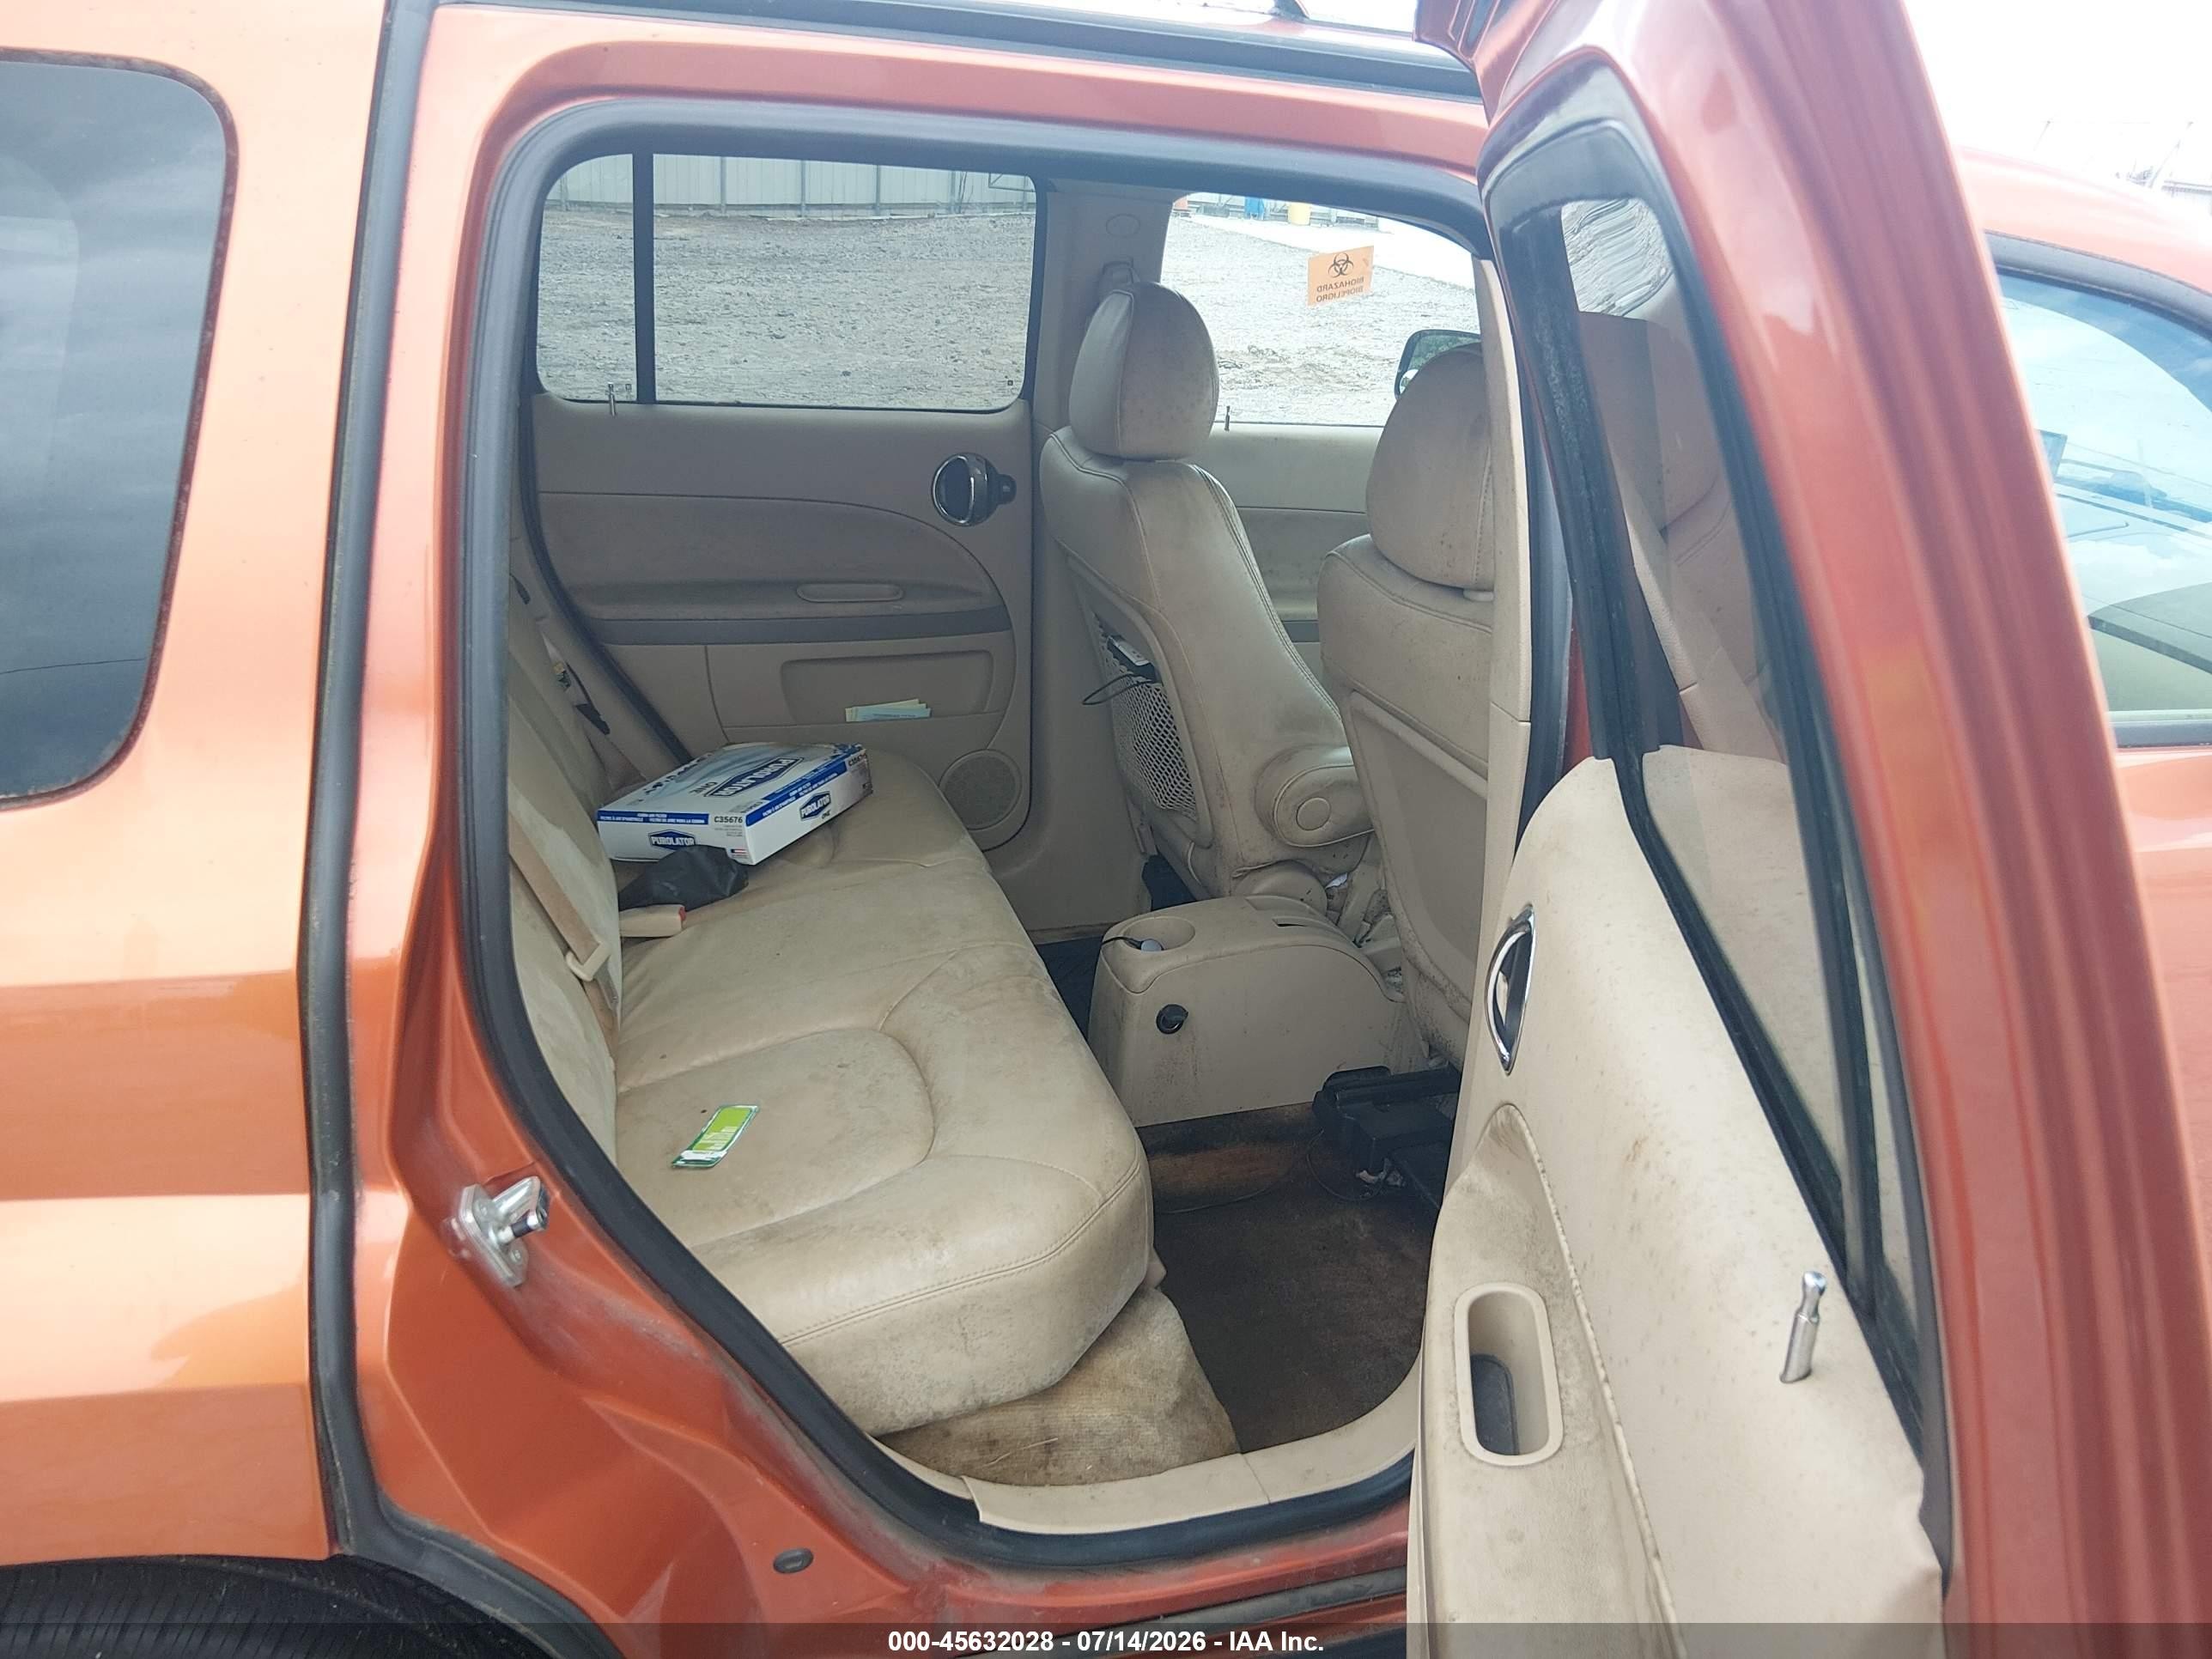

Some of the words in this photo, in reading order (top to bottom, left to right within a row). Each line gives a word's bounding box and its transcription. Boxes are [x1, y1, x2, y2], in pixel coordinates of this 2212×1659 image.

[714, 758, 794, 796] PUROLATOR
[800, 794, 831, 818] PUROLATOR
[714, 815, 744, 823] C35676
[651, 836, 696, 846] PUROLATOR
